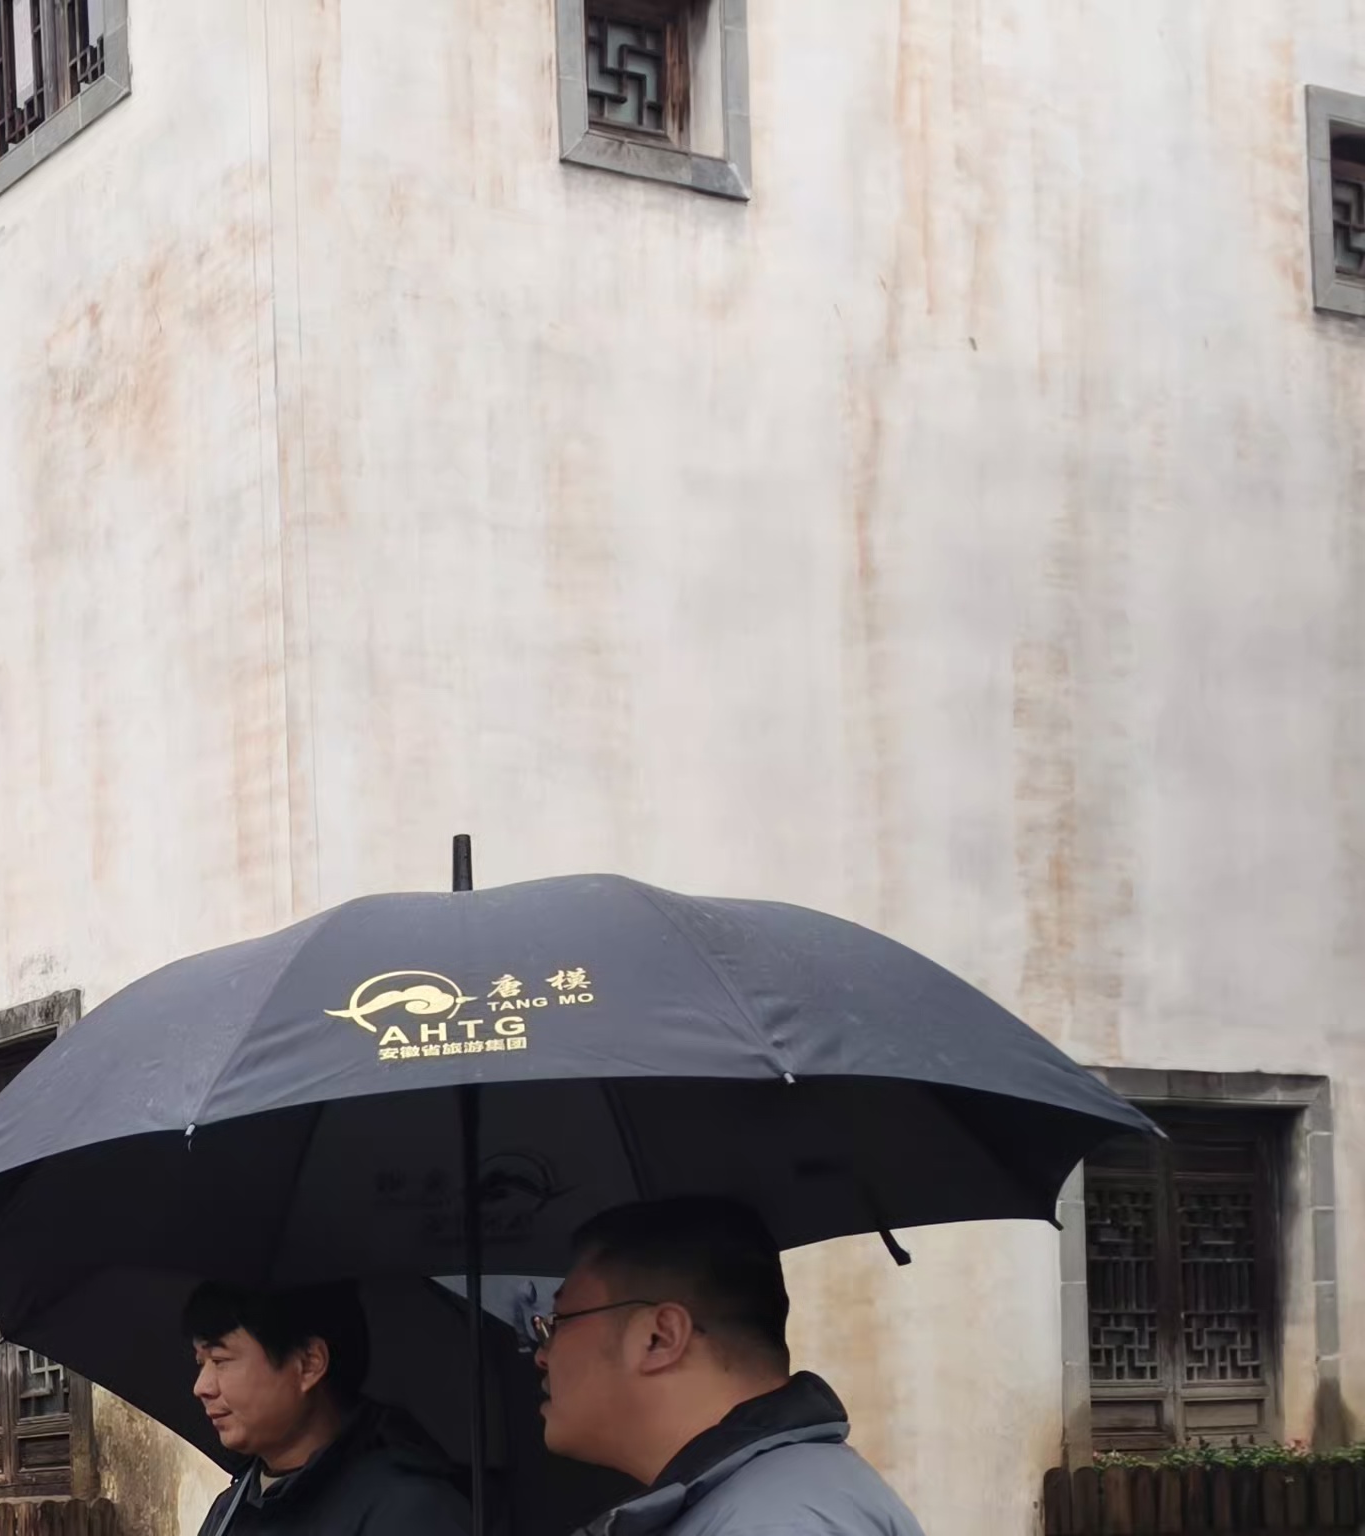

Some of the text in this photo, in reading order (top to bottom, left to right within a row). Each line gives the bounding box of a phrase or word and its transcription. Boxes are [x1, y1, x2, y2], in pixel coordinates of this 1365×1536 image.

[487, 993, 594, 1012] TANG MO
[379, 1016, 525, 1046] AHTG
[379, 1037, 527, 1060] 安徽省旅游集团
